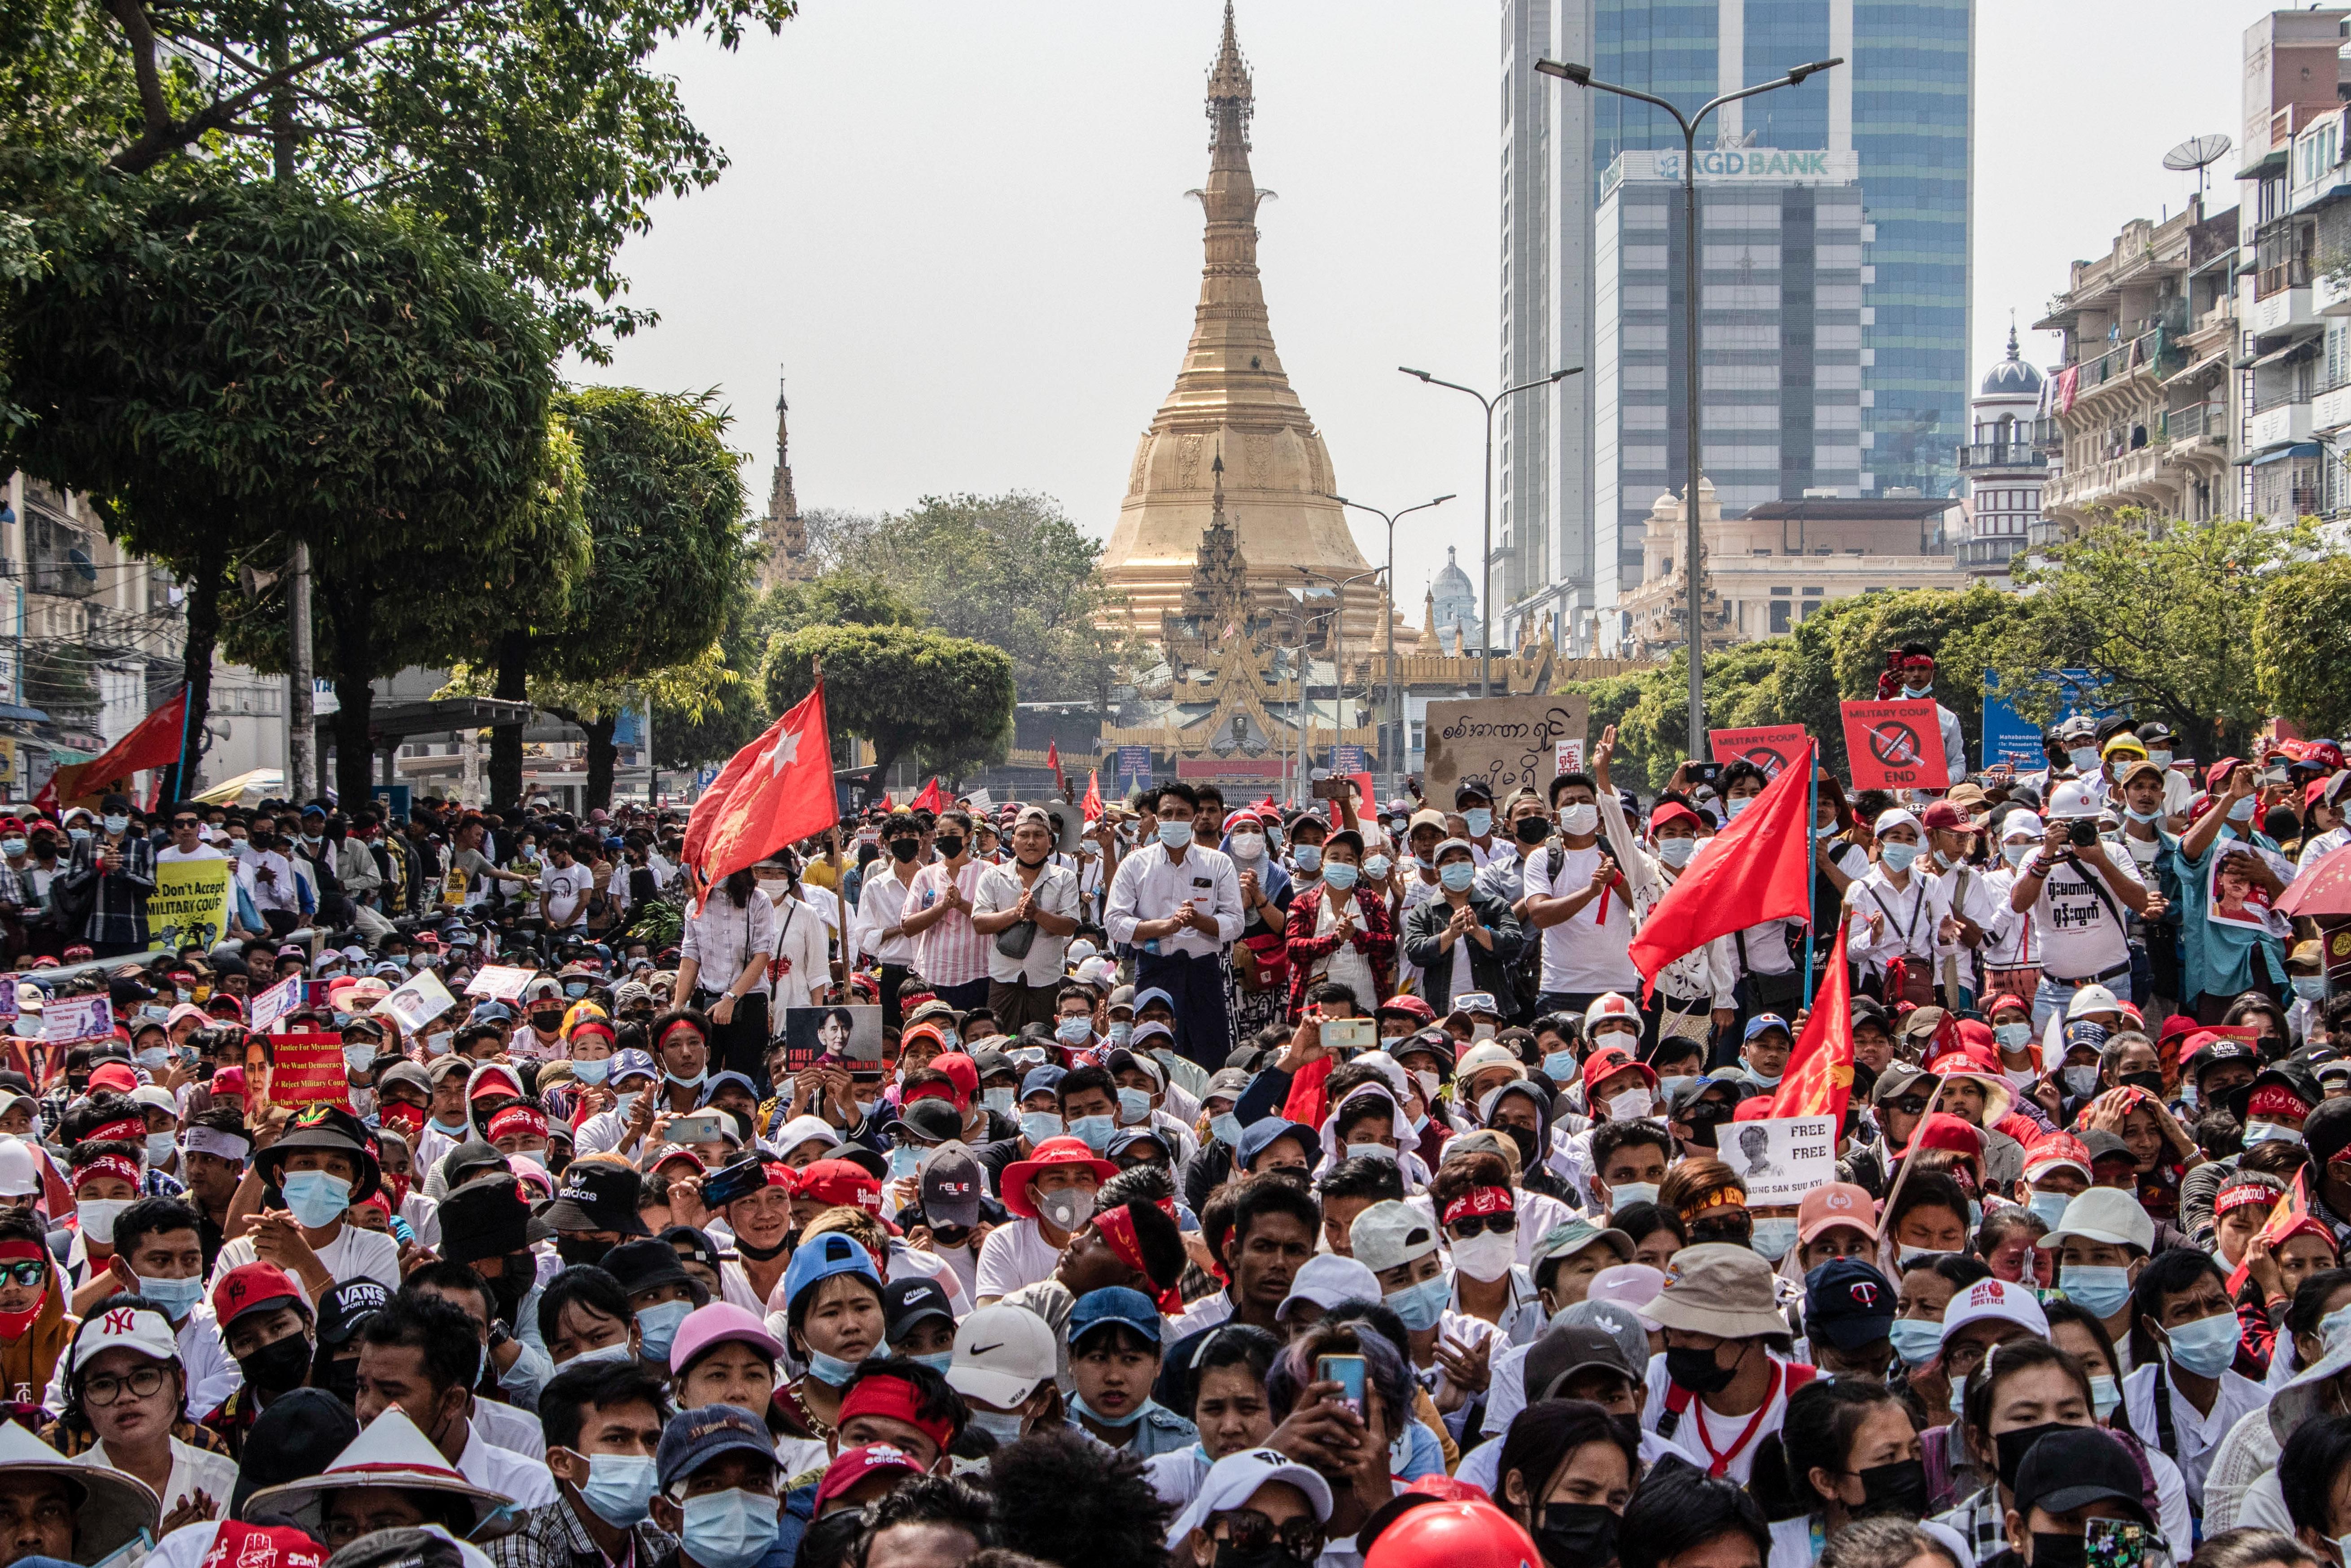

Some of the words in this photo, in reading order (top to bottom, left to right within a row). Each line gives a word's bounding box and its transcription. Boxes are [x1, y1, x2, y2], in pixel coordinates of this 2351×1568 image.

[1683, 152, 1743, 175] AGD
[1749, 152, 1829, 175] BANK
[1849, 709, 1896, 718] MILITARY
[1899, 708, 1930, 716] COUP
[1718, 735, 1767, 746] MILITARY
[1769, 733, 1799, 744] COUP
[702, 770, 713, 783] P
[1885, 771, 1916, 782] END
[1953, 802, 1966, 822] POLO
[162, 883, 192, 897] Don't
[195, 881, 225, 894] Accept
[146, 899, 195, 916] MILITARY
[196, 897, 222, 911] COUP
[2053, 901, 2099, 927] ရုန်းထွက်
[311, 1043, 341, 1052] Myanmar
[2211, 1041, 2236, 1052] VANS
[789, 1048, 813, 1061] FREE
[308, 1062, 342, 1070] Democracy
[614, 1052, 625, 1072] NIKE
[789, 1062, 806, 1071] DAW
[864, 1061, 878, 1070] KYI
[281, 1081, 299, 1089] Reject
[337, 1097, 347, 1105] Kyi
[1791, 1124, 1826, 1137] FREE
[1792, 1146, 1826, 1160] FREE
[1748, 1186, 1769, 1194] AUNG
[1792, 1183, 1808, 1191] SUU
[1810, 1179, 1822, 1188] KYI
[559, 1188, 597, 1202] adidas
[336, 1283, 386, 1306] VANS
[1972, 1283, 1988, 1295] WE
[1970, 1298, 2005, 1308] JUSTICE
[1971, 1292, 1988, 1301] WANT
[341, 1301, 365, 1313] SPORT
[103, 1307, 135, 1335] NY
